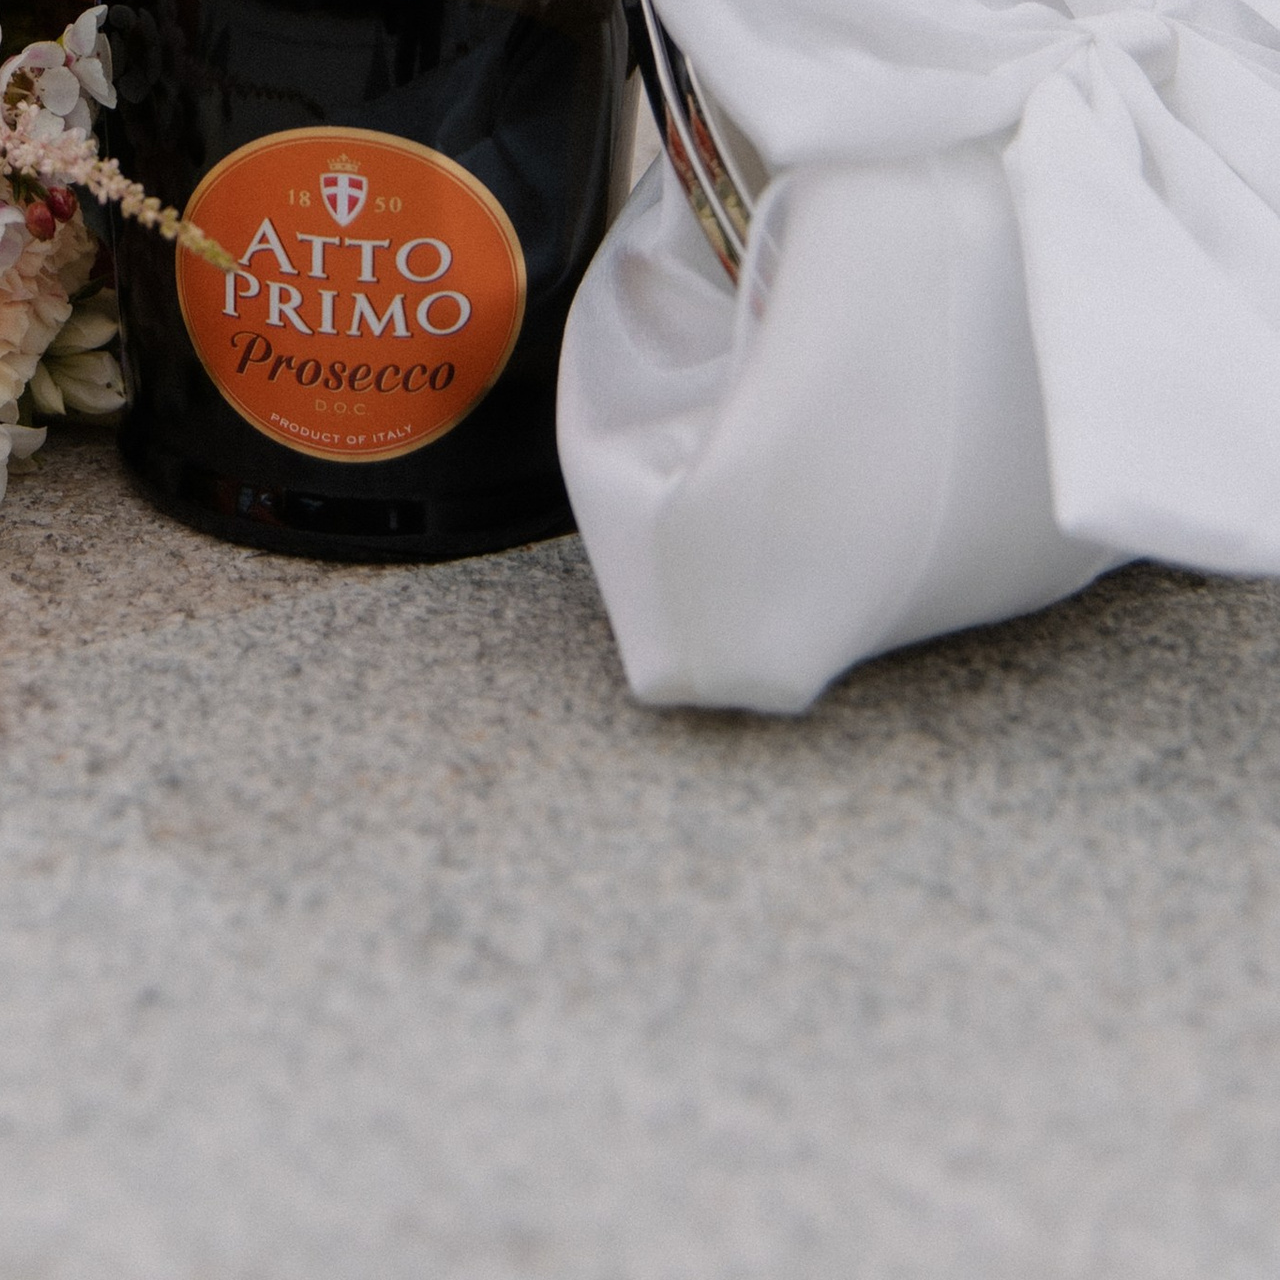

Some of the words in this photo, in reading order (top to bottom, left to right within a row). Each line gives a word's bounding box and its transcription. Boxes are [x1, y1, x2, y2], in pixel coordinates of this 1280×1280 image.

[237, 217, 453, 283] ATTO
[222, 268, 472, 338] PRIMO
[230, 331, 456, 393] Prosecco
[270, 412, 340, 445] PRODUCT
[346, 434, 367, 445] OF
[372, 424, 413, 443] ITALY
[315, 399, 370, 416] D.O.C.
